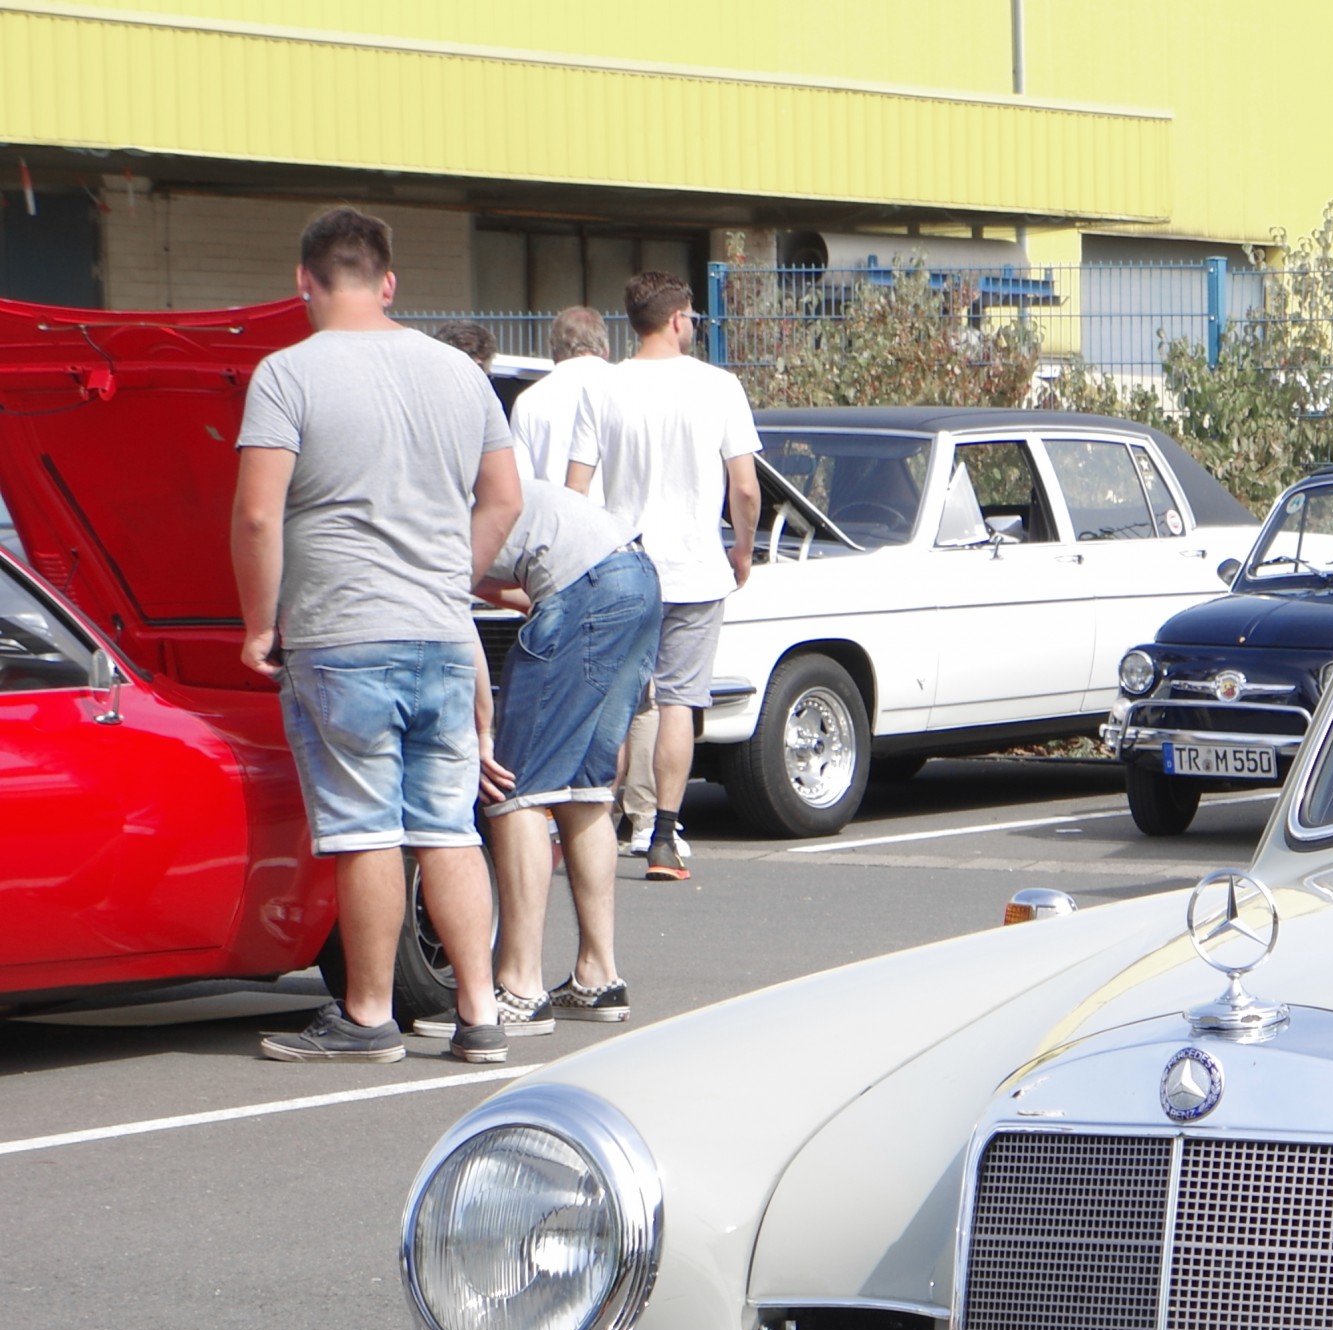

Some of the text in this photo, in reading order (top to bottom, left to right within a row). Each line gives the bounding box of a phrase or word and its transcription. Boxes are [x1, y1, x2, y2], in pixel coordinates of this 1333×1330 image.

[1174, 747, 1272, 774] TR M 550
